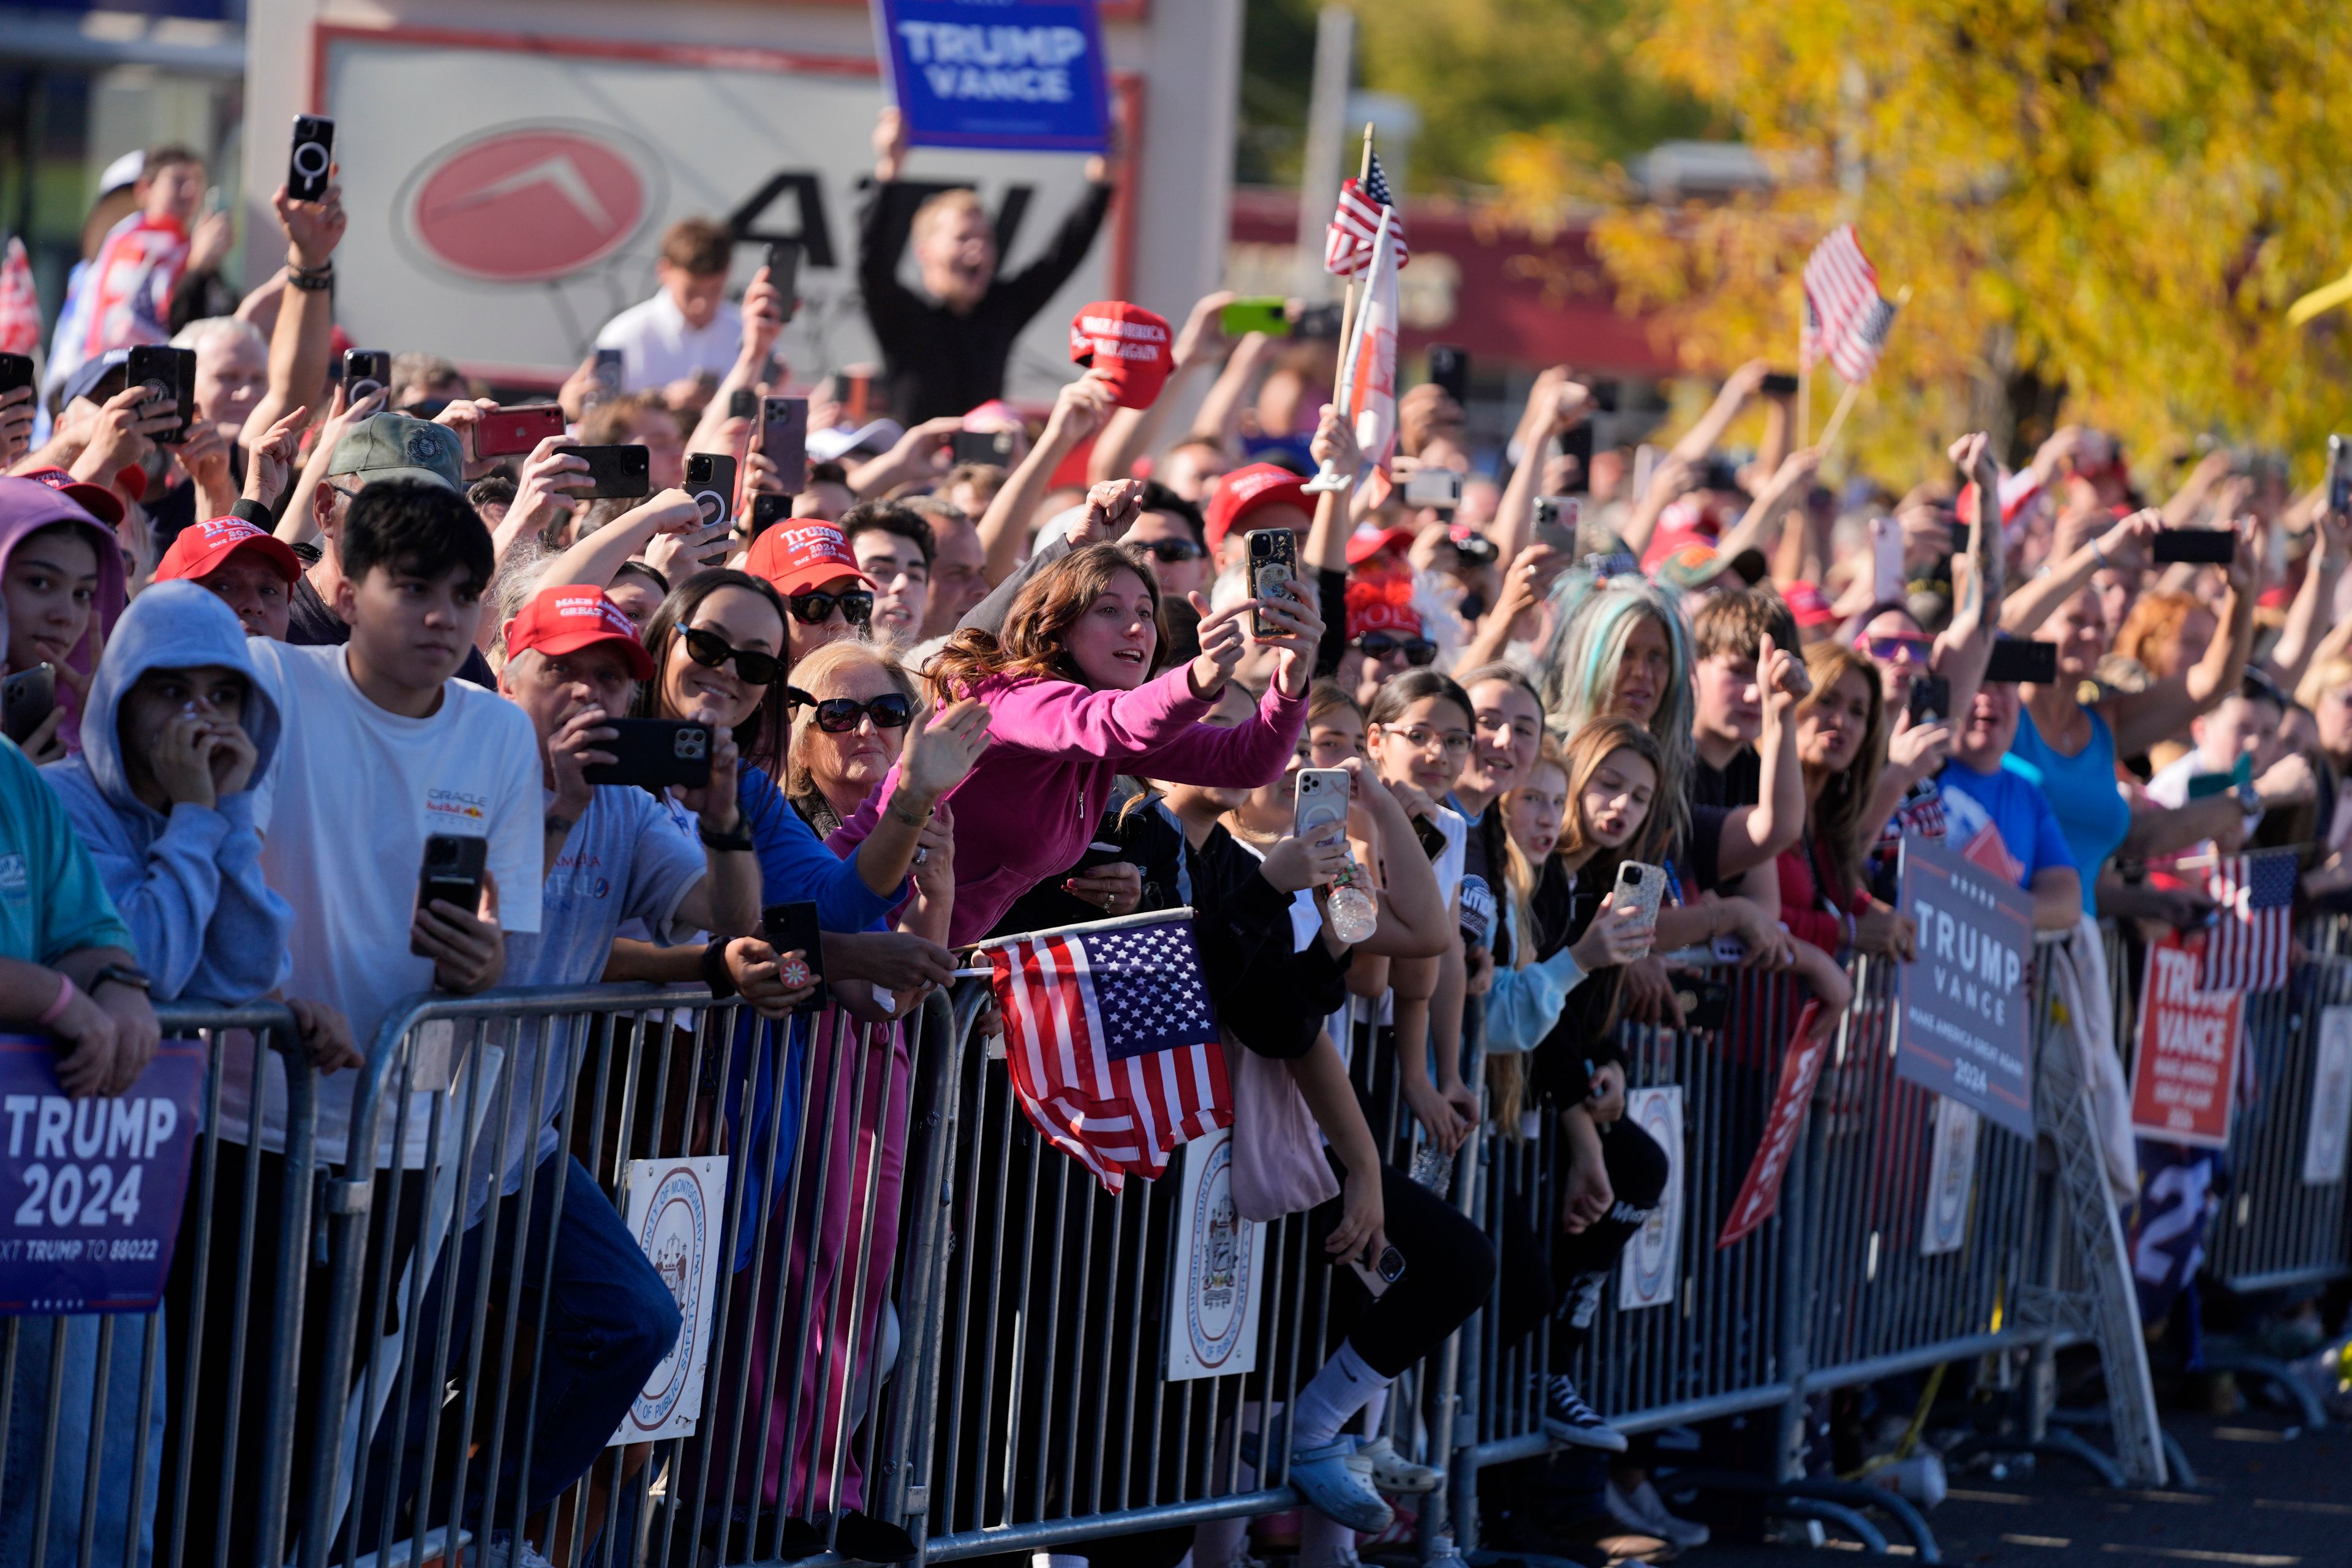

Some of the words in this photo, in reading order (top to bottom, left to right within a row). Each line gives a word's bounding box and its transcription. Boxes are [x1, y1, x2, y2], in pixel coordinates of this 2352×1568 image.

[898, 20, 1087, 66] TRUMP
[923, 63, 1073, 102] VANCE
[780, 526, 845, 547] Trump
[809, 543, 836, 553] 2024
[794, 556, 810, 567] TAKE
[555, 598, 594, 608] MAKE
[560, 606, 603, 617] GREAT
[428, 788, 488, 807] ORACLE
[1915, 899, 2021, 995] TRUMP
[1934, 965, 2006, 1028] VANCE
[2156, 948, 2242, 1014] TRU
[2157, 1008, 2227, 1063] VANCE
[1954, 1057, 1988, 1094] 2024
[4, 1094, 178, 1159] TRUMP
[14, 1163, 143, 1227] 2024
[643, 1203, 659, 1252] UNTY
[660, 1184, 670, 1205] OF
[26, 1238, 84, 1262] TRUMP
[86, 1238, 108, 1262] TO
[642, 1404, 653, 1419] OF
[654, 1378, 681, 1417] PUBLIC
[680, 1299, 697, 1371] SAFETY
